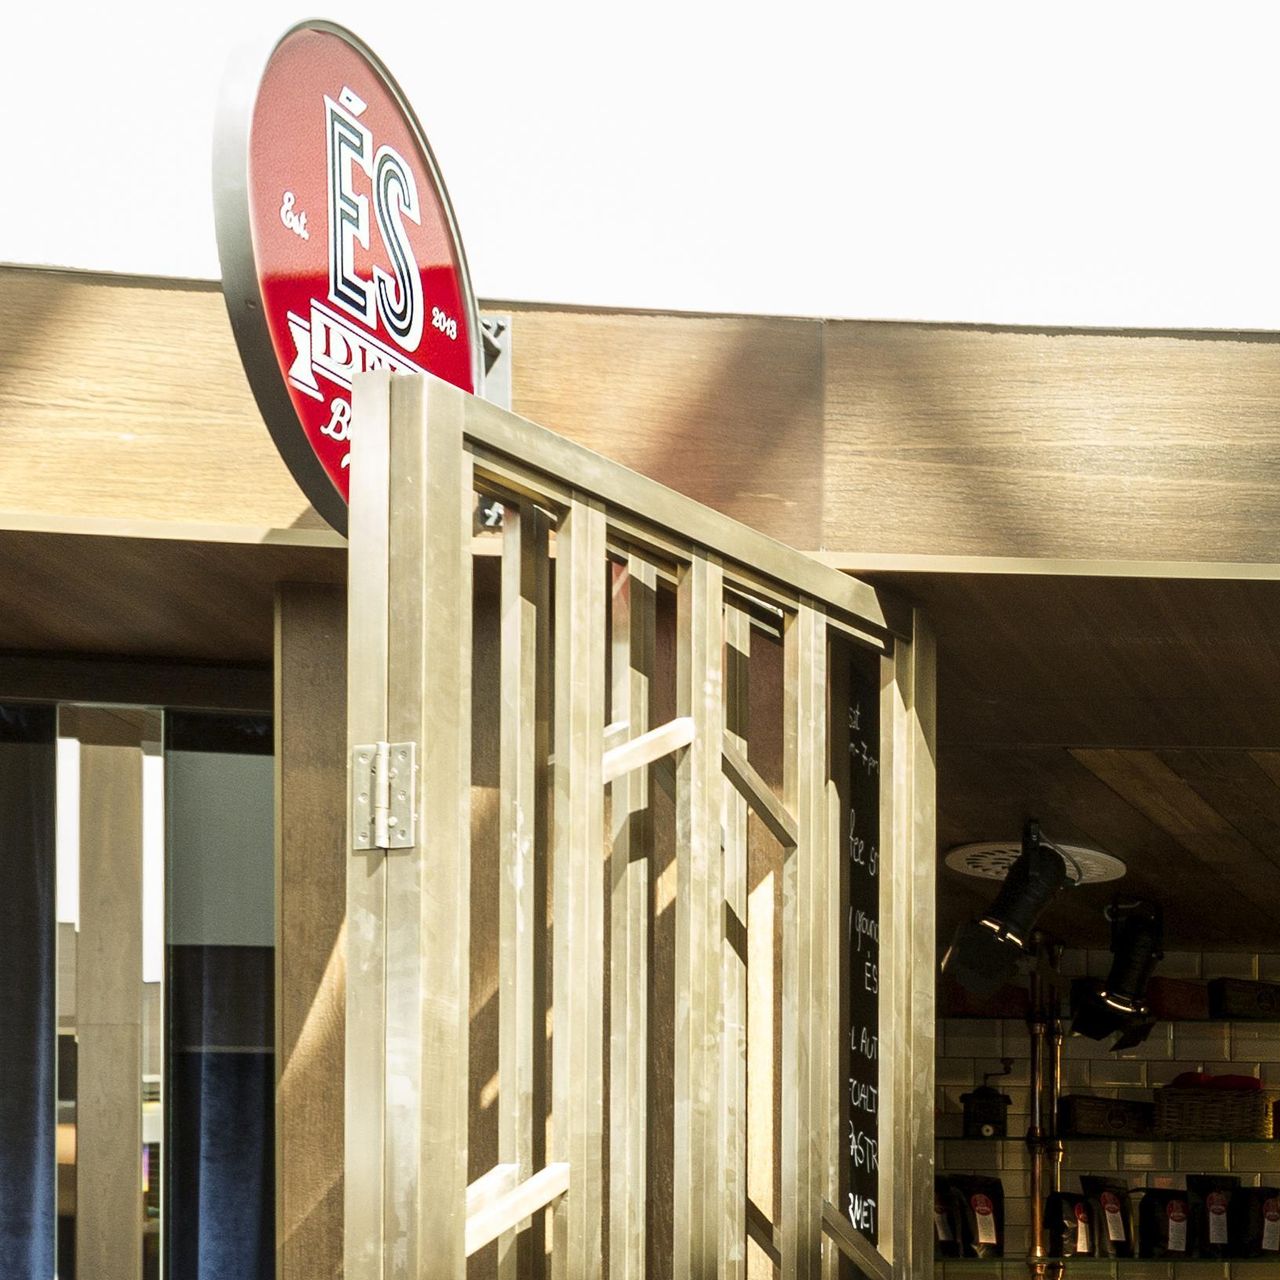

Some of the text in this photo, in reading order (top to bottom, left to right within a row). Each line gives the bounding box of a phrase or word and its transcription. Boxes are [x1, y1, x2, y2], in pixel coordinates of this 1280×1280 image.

[280, 191, 309, 240] Est.
[323, 86, 424, 353] ÉS
[432, 307, 457, 340] 2013
